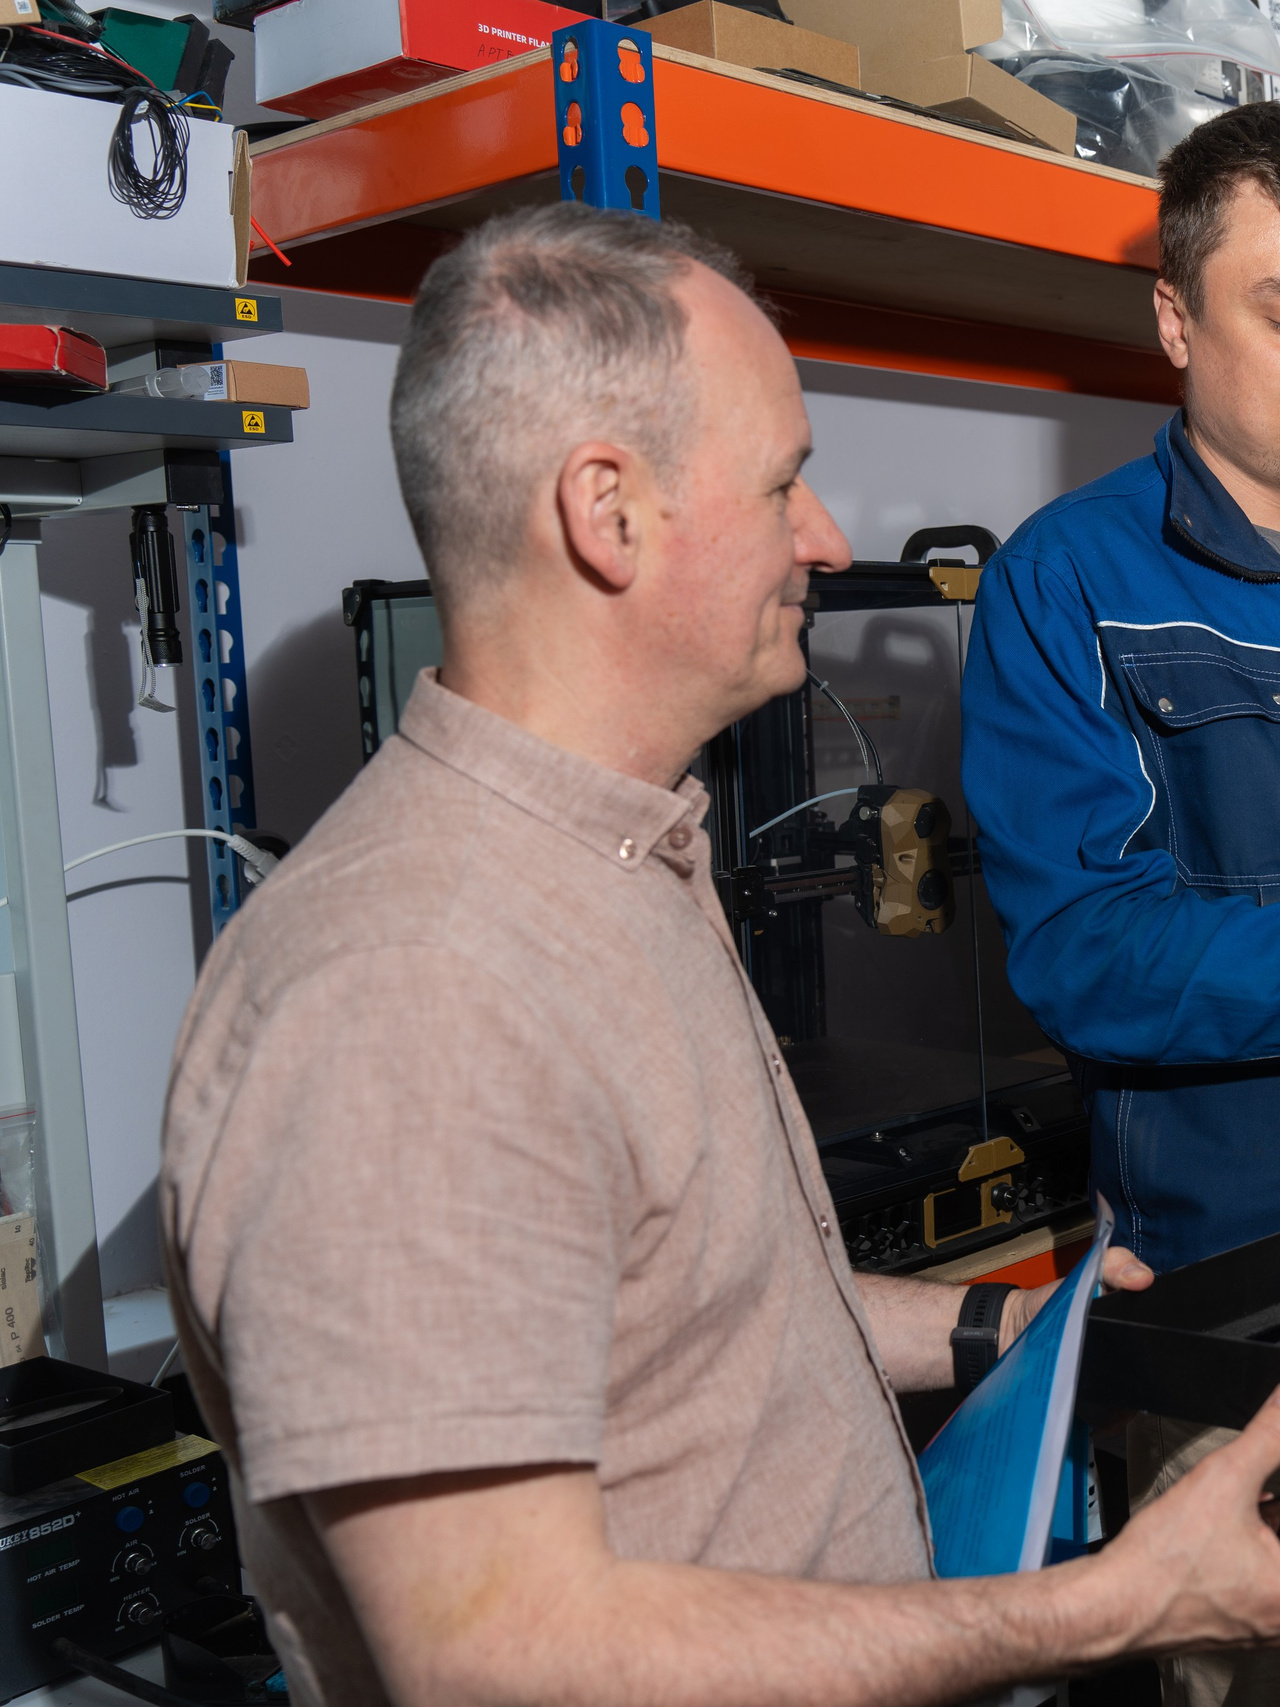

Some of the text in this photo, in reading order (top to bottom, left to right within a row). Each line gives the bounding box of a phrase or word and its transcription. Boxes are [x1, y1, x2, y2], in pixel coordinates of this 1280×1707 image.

[478, 23, 490, 34] 3D
[491, 26, 527, 44] PRINTER
[5, 1307, 16, 1328] 400
[11, 1331, 20, 1341] P
[180, 1465, 206, 1478] SOLDER
[112, 1487, 140, 1502] HOT AIR
[185, 1512, 211, 1526] SOLDER
[125, 1539, 138, 1549] AIR
[27, 1559, 80, 1583] HOT AIR TEMP
[123, 1587, 151, 1601] HEATER
[32, 1604, 85, 1629] SOLDER TEMP
